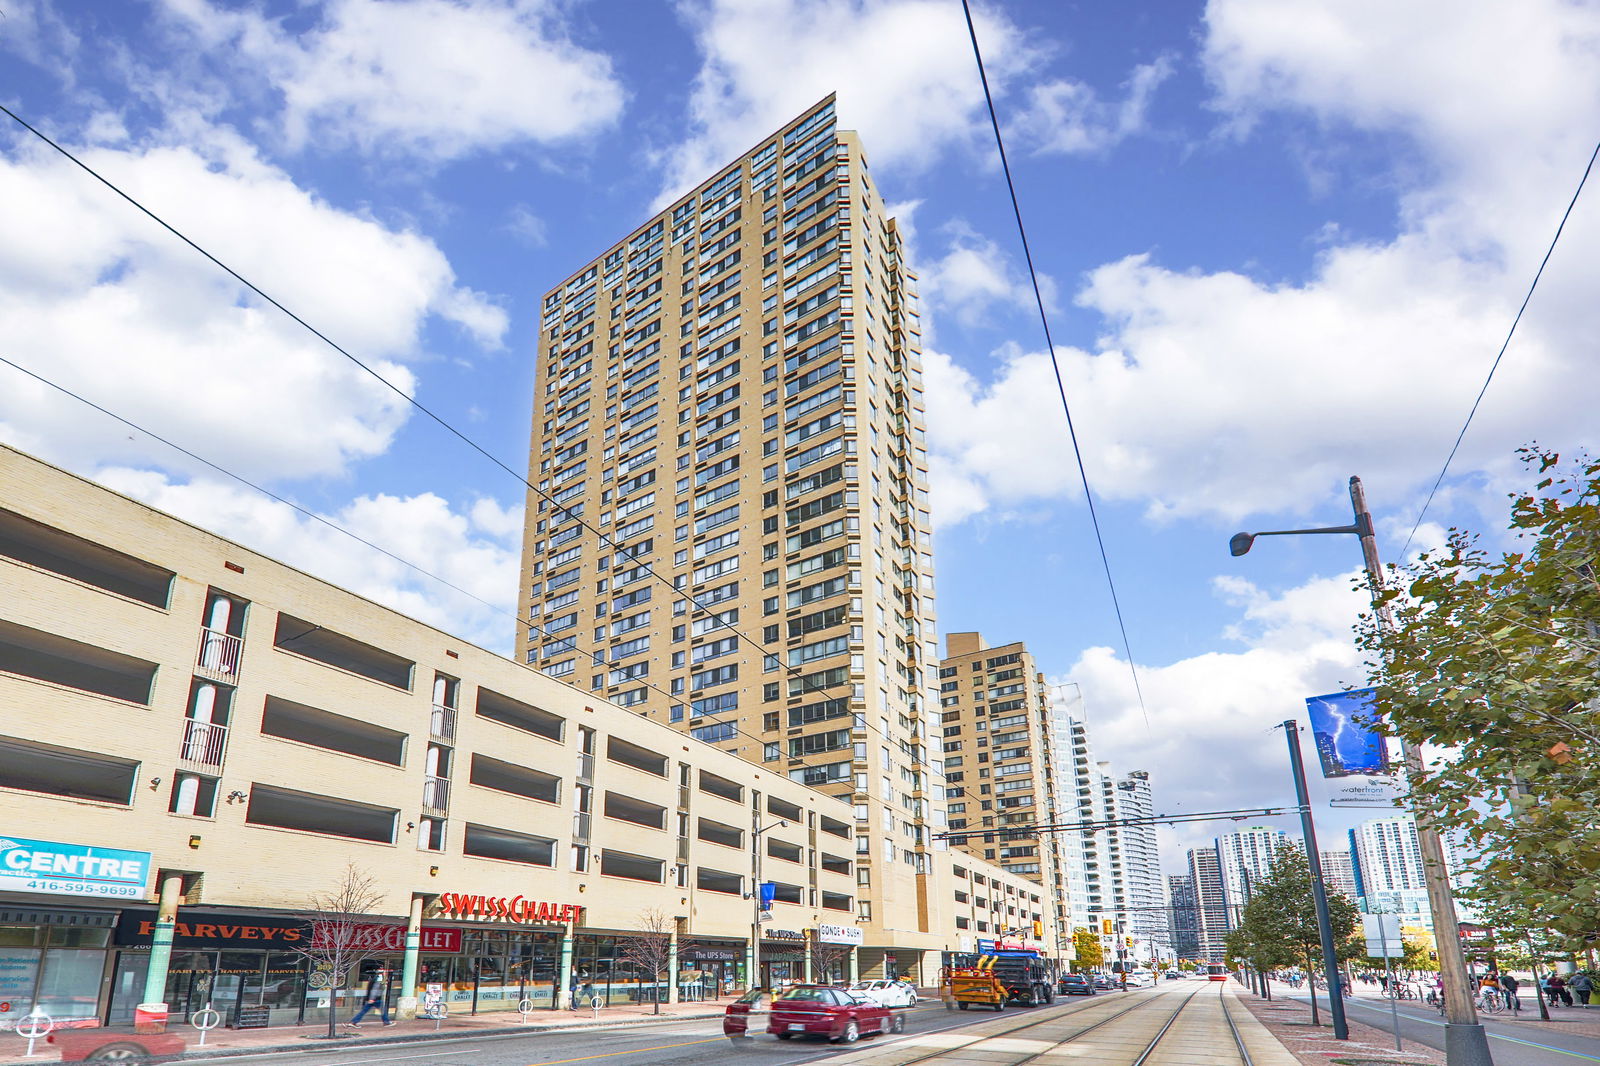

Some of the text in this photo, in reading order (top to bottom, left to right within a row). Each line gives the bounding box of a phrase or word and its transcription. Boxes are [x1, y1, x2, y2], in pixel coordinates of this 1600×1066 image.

[5, 849, 140, 879] CENTRE
[27, 880, 137, 896] 416-595-9699
[695, 951, 734, 960] The UPS Store
